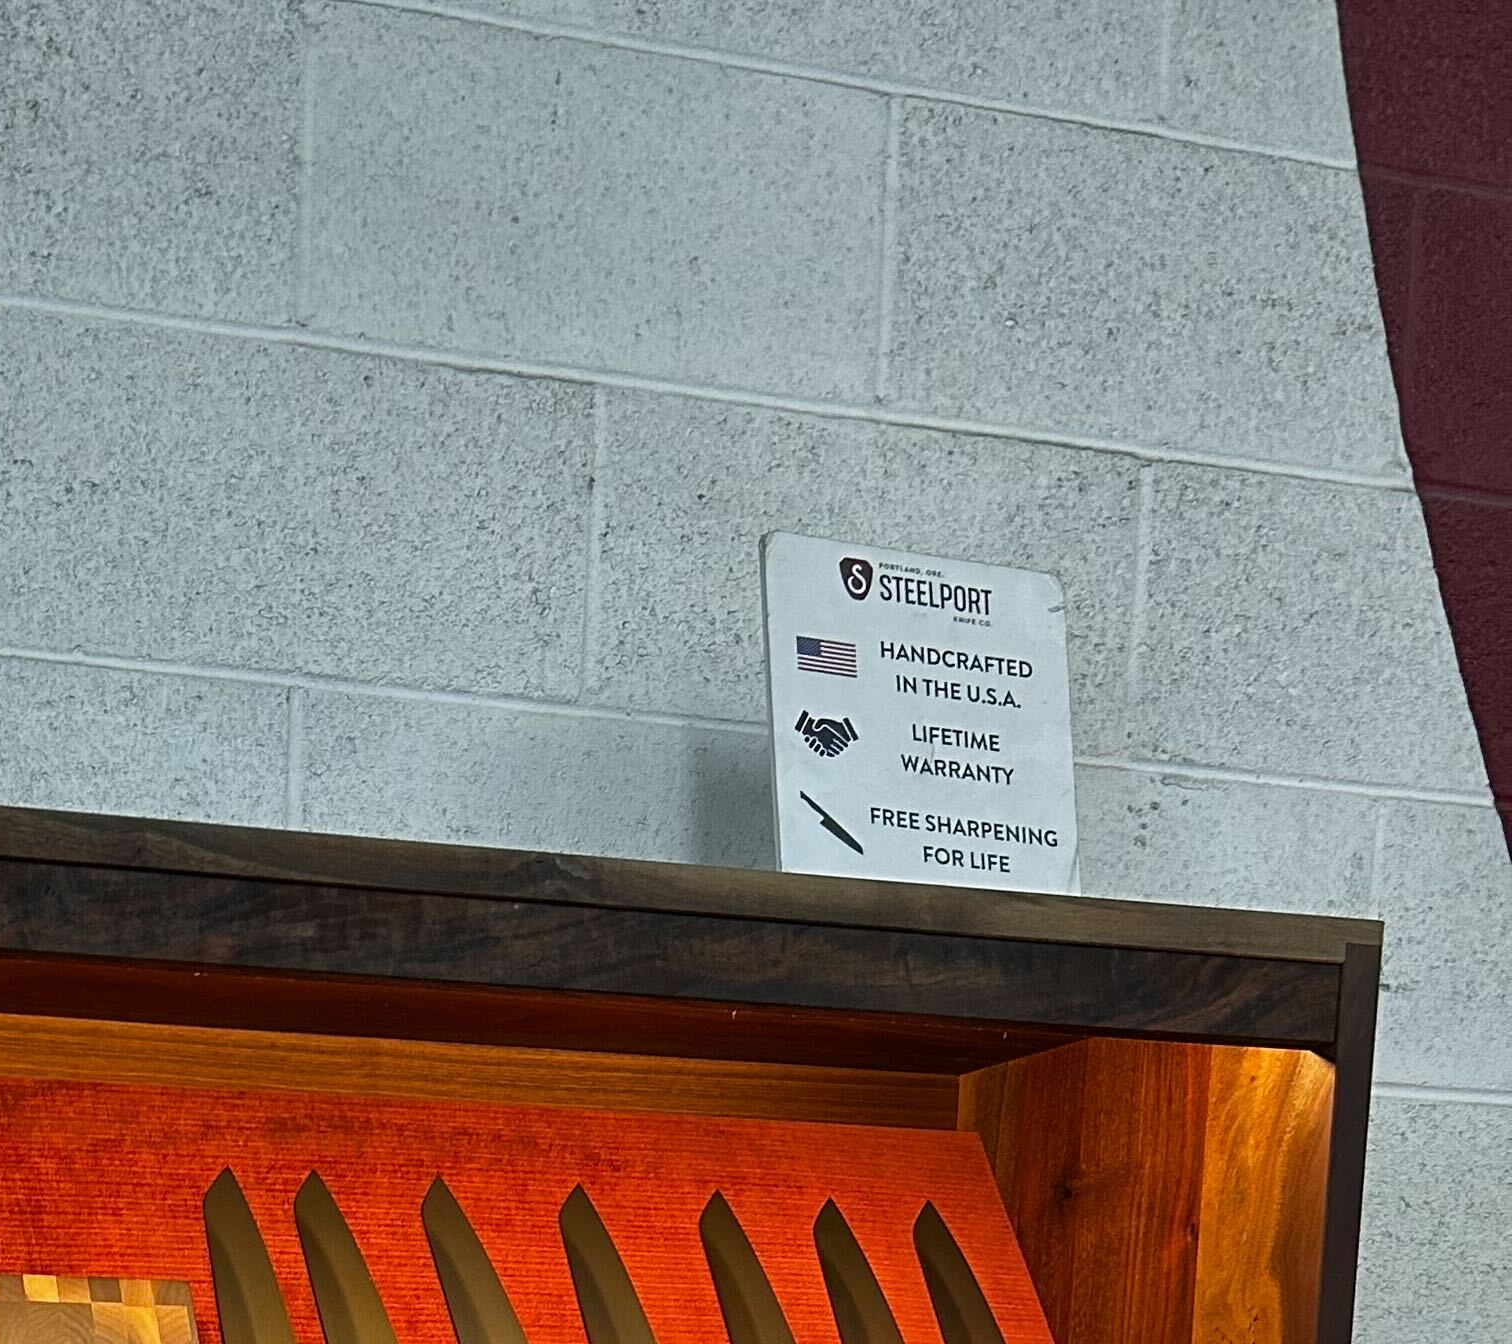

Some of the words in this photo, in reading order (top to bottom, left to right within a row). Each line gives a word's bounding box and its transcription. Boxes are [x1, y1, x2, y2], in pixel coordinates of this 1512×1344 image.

[879, 574, 992, 615] STEELPORT
[880, 640, 1033, 678] HANDCRAFTED
[896, 674, 917, 695] IN
[922, 678, 961, 700] THE
[968, 686, 1021, 709] U.S.A.
[912, 723, 1001, 752] LIFETIME
[901, 753, 1014, 785] WARRANTY
[870, 807, 920, 830] FREE
[925, 815, 1058, 847] SHARPENING
[923, 846, 964, 867] FOR
[970, 852, 1011, 873] LIFE
